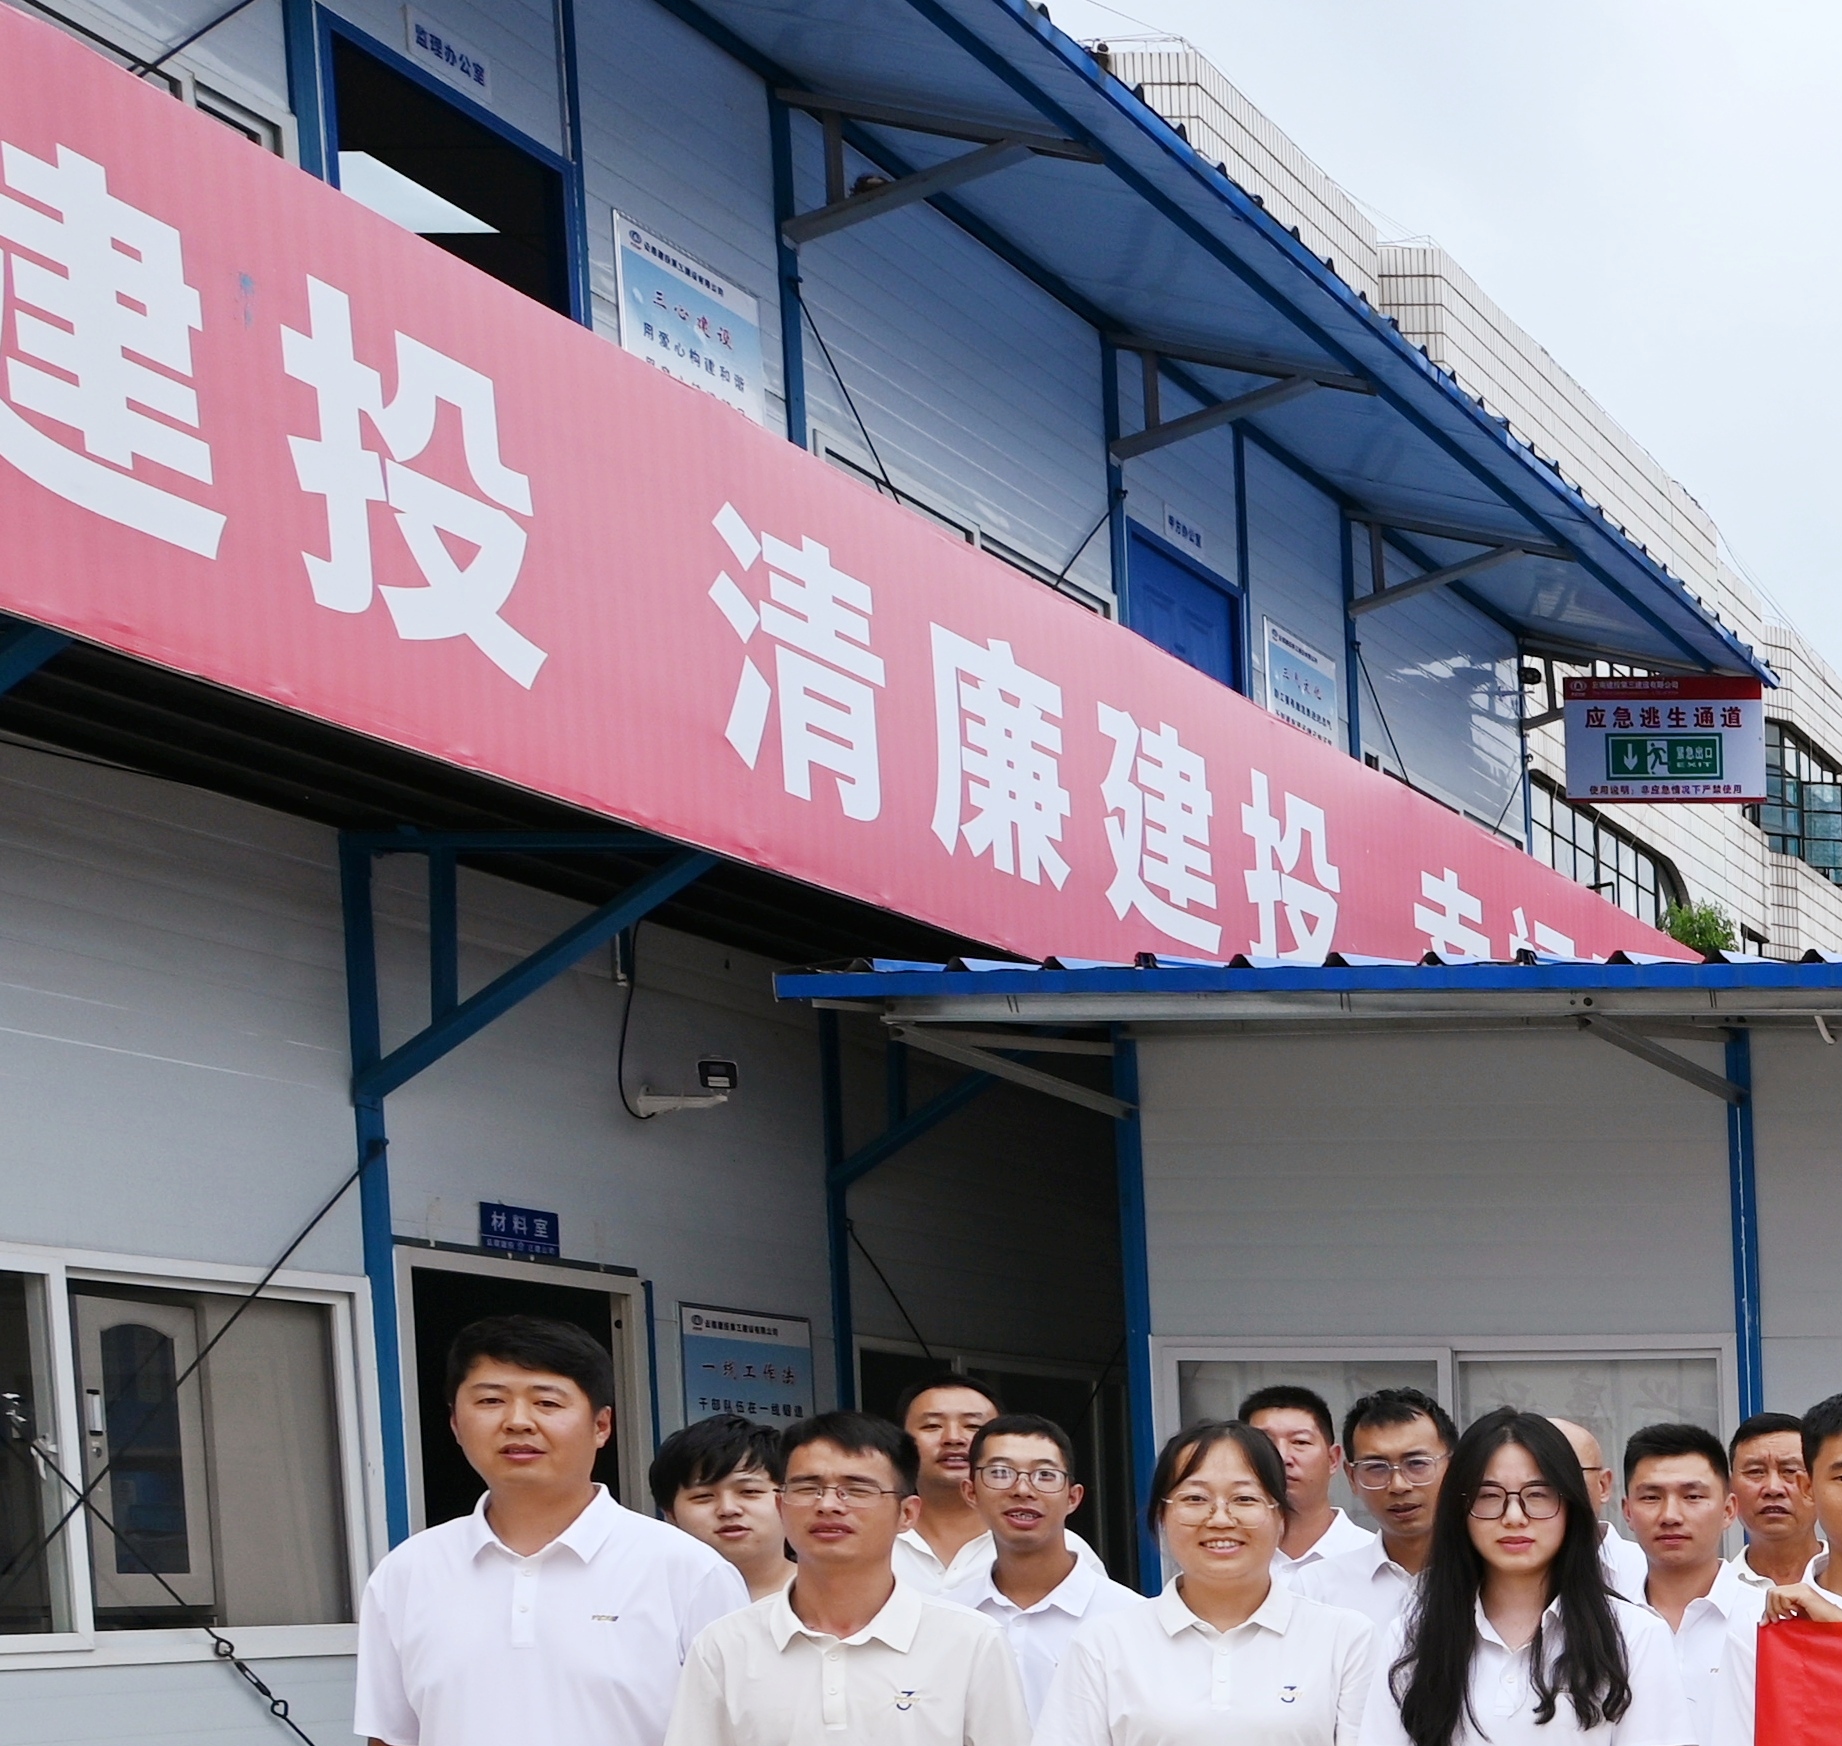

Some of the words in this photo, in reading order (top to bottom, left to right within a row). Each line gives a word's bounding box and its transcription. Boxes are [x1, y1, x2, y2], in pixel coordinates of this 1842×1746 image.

[1585, 706, 1743, 729] 应急逃生通道
[709, 501, 1340, 962] 清廉建投
[1676, 746, 1713, 760] 紧急出口
[491, 1210, 549, 1238] 材料室
